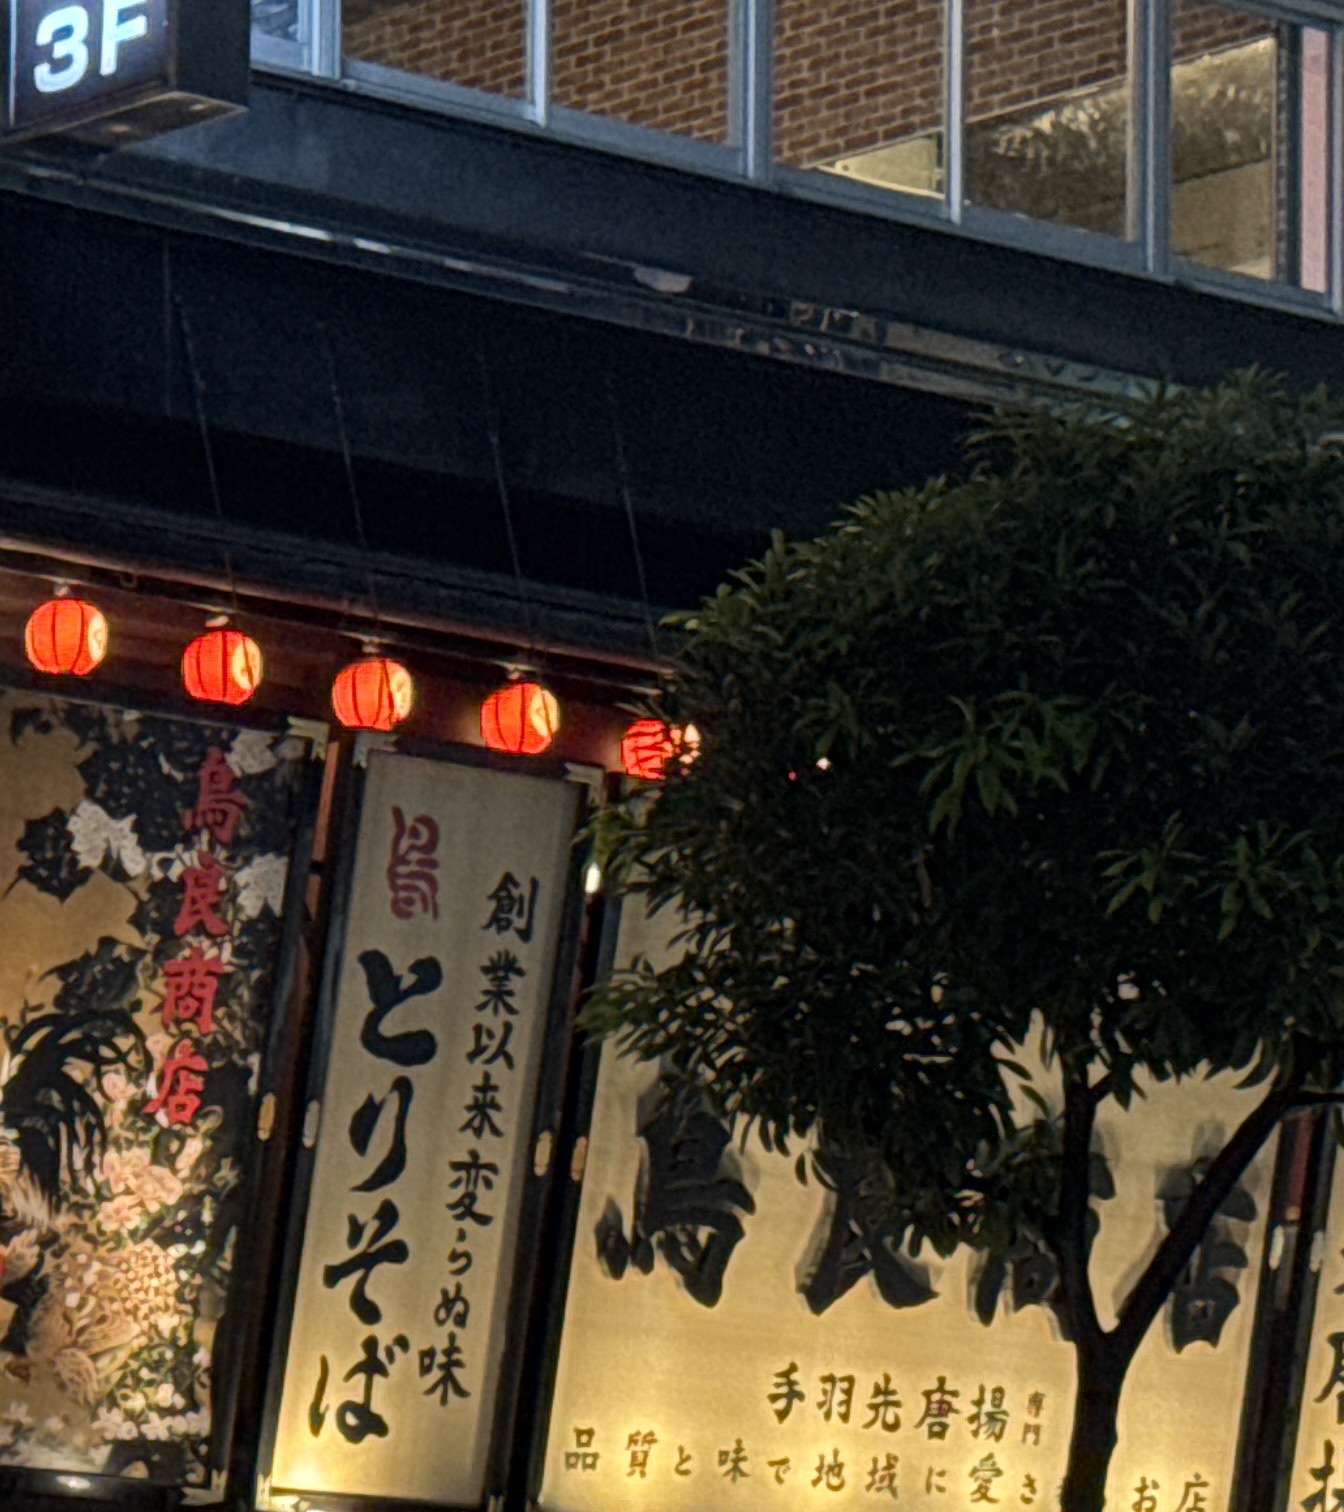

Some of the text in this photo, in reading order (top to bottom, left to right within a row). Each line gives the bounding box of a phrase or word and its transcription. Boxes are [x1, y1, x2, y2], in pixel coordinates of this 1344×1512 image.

[33, 0, 149, 94] 3F
[144, 746, 248, 1128] 鳥良商店
[310, 948, 445, 1446] とりそば
[418, 870, 542, 1407] 創業以来変らぬ味
[766, 1360, 1012, 1445] 手羽先唐揚
